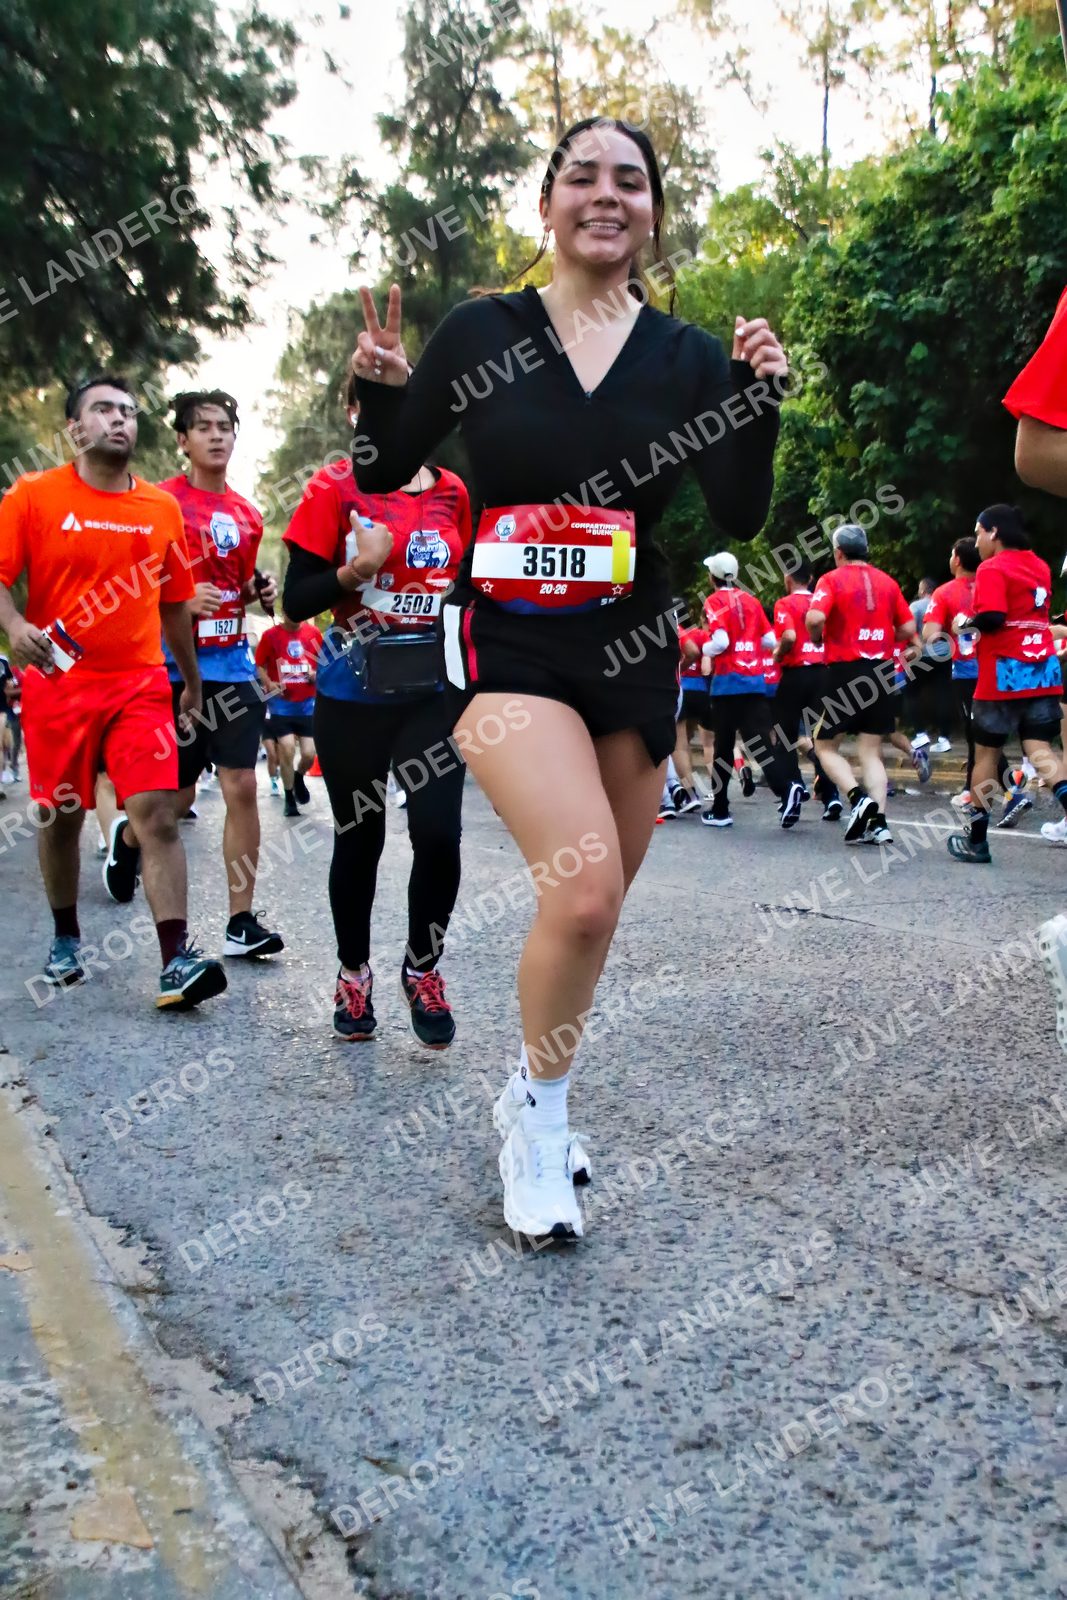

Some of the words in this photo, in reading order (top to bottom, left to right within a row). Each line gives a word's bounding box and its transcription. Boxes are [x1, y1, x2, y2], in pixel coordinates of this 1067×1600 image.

[523, 546, 586, 578] 3518
[391, 594, 434, 614] 2508
[214, 620, 233, 635] 1527
